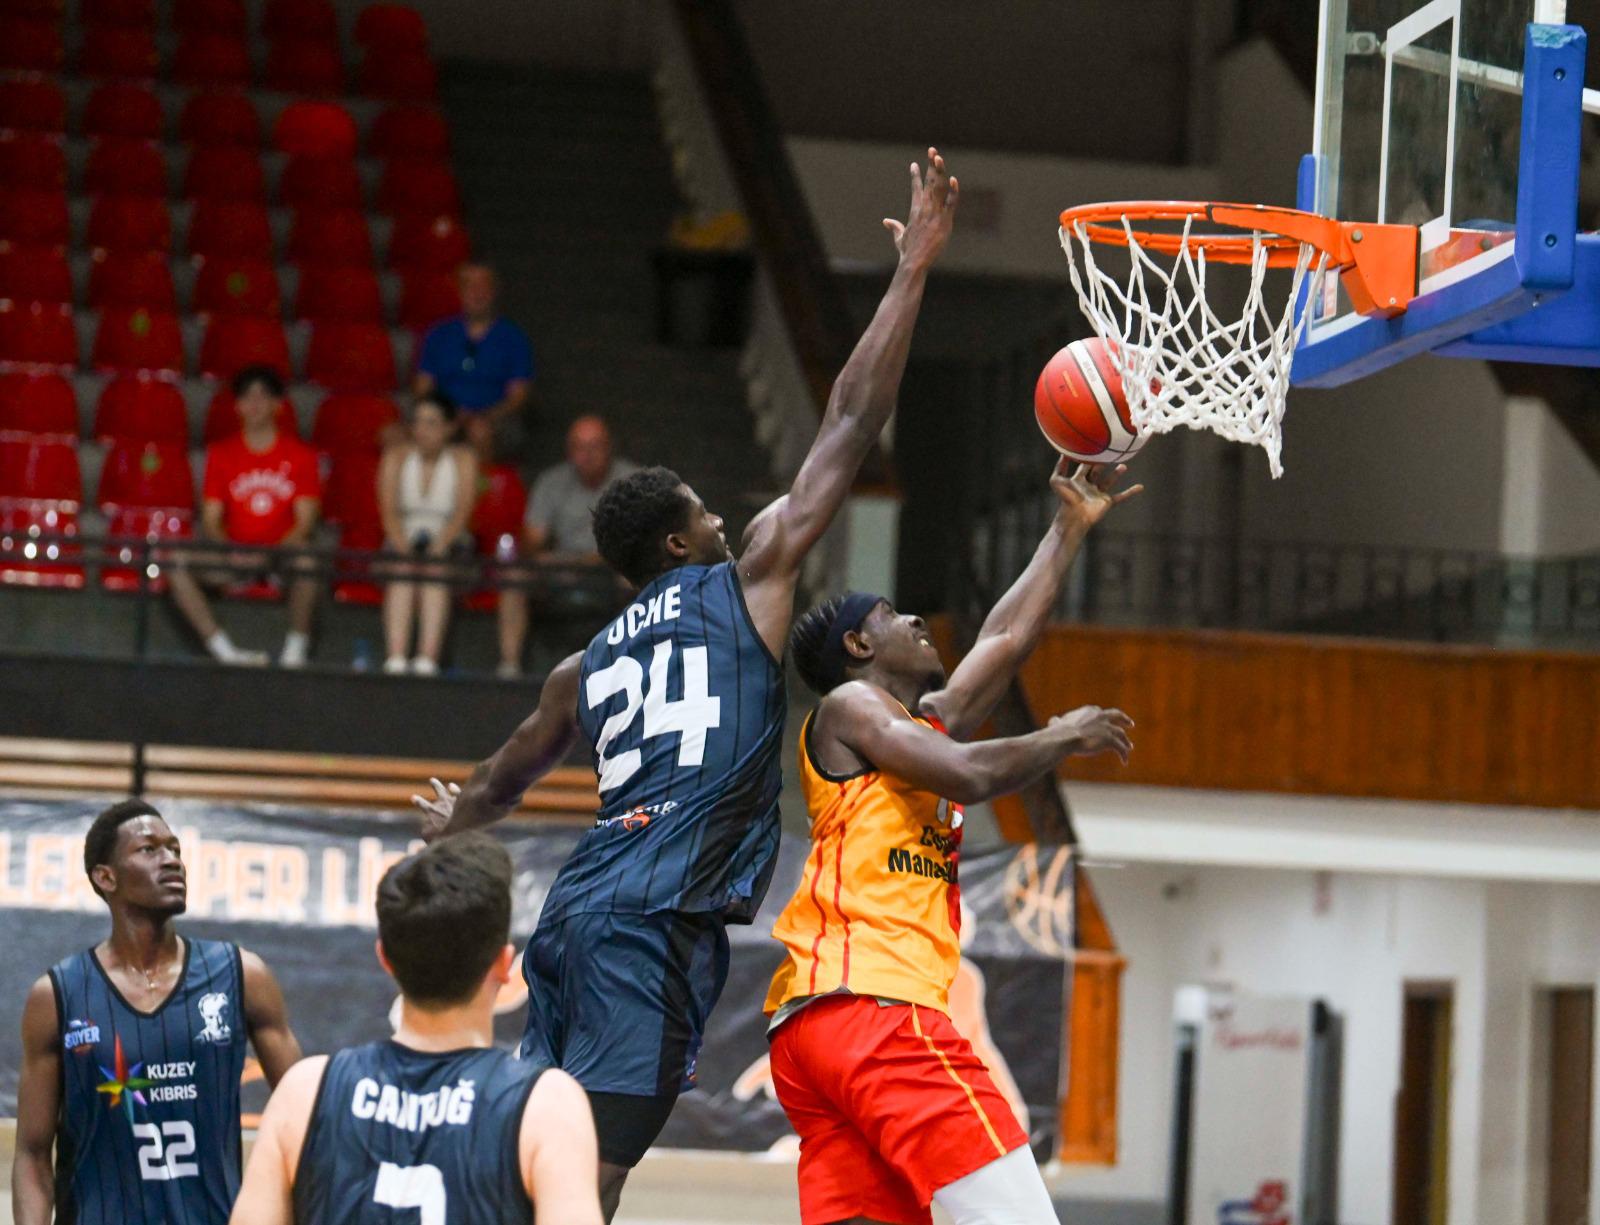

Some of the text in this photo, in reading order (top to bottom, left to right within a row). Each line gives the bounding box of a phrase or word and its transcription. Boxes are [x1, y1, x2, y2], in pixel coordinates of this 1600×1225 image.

[585, 638, 721, 795] 24
[146, 1060, 197, 1081] KUZEY
[149, 1083, 198, 1103] KIBRIS
[132, 1119, 199, 1181] 22
